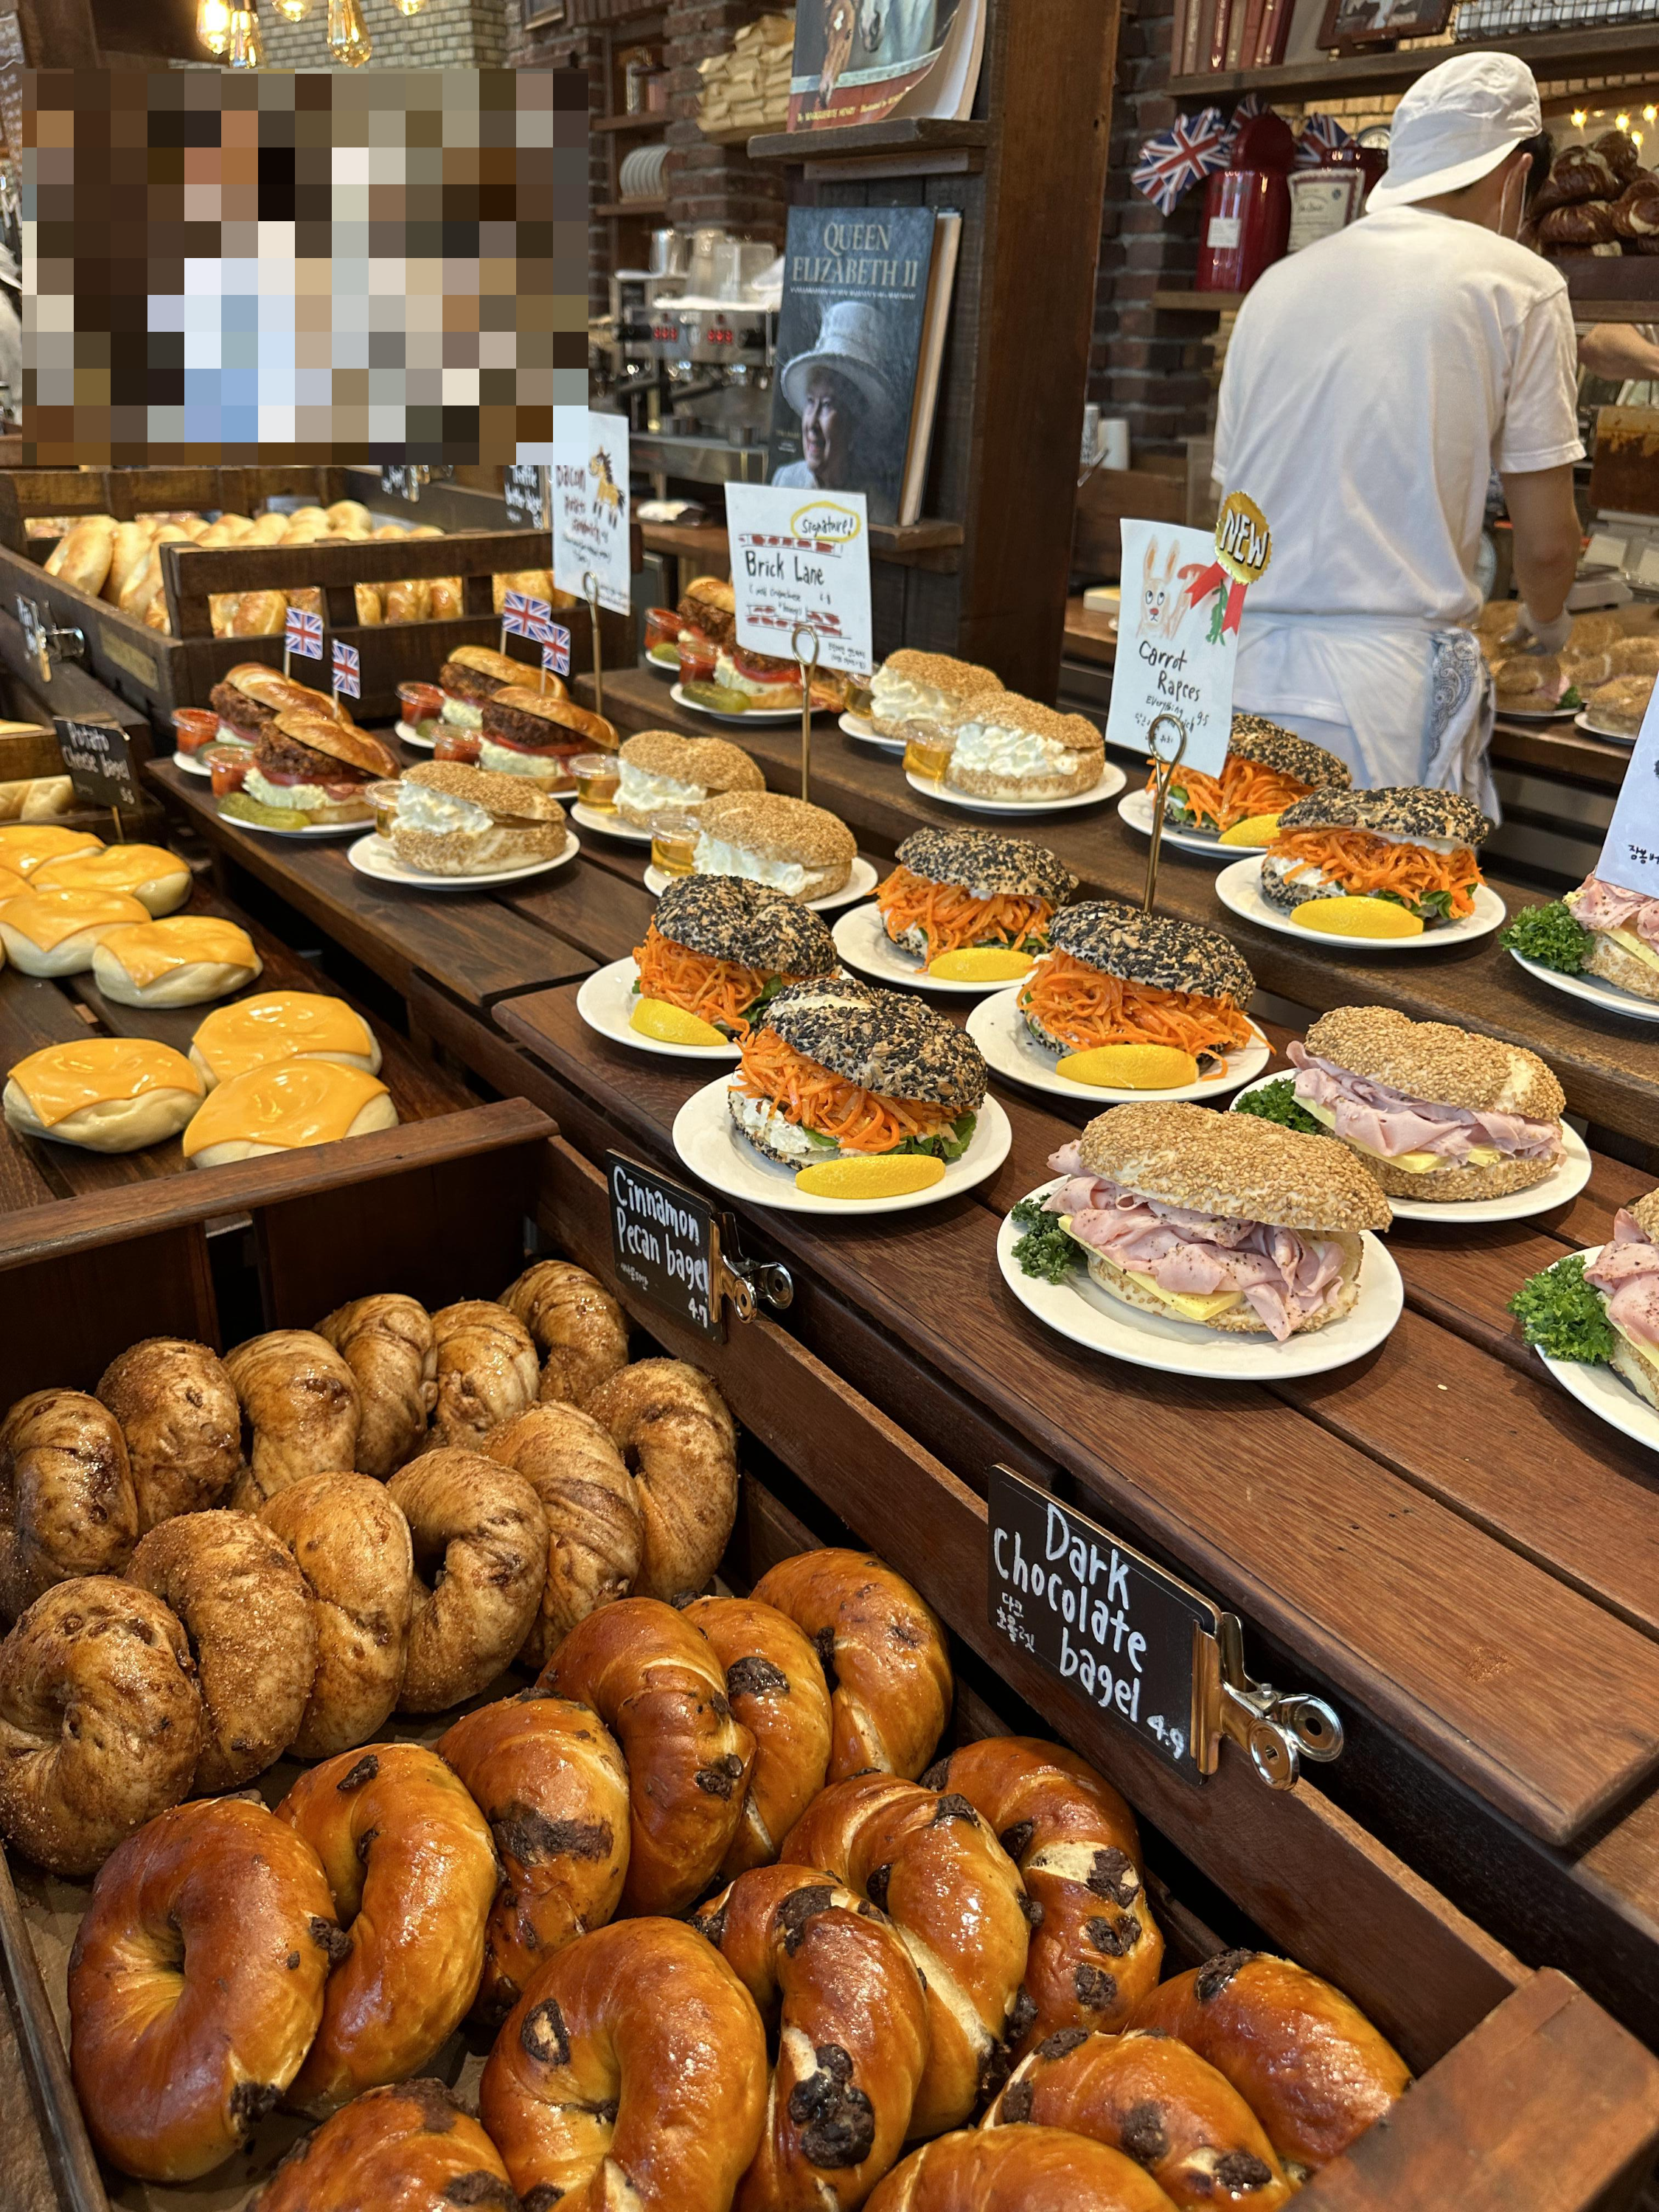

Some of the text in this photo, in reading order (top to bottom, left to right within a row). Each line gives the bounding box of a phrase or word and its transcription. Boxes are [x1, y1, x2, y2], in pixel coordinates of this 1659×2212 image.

[824, 222, 892, 257] QUEEN
[792, 256, 918, 288] ELIZABETH II
[1220, 509, 1270, 571] NEW
[745, 551, 825, 585] Brick Lane
[1139, 640, 1187, 672] Carrot
[613, 1165, 700, 1246] Cinnamon
[616, 1206, 709, 1295] Pecan bagel
[688, 1297, 708, 1328] 4.7
[1045, 1503, 1130, 1610] Dark
[994, 1528, 1147, 1673] Chocolate
[1001, 1592, 1024, 1618] 다크
[1059, 1627, 1141, 1722] bagel
[1147, 1714, 1185, 1760] 4.9
